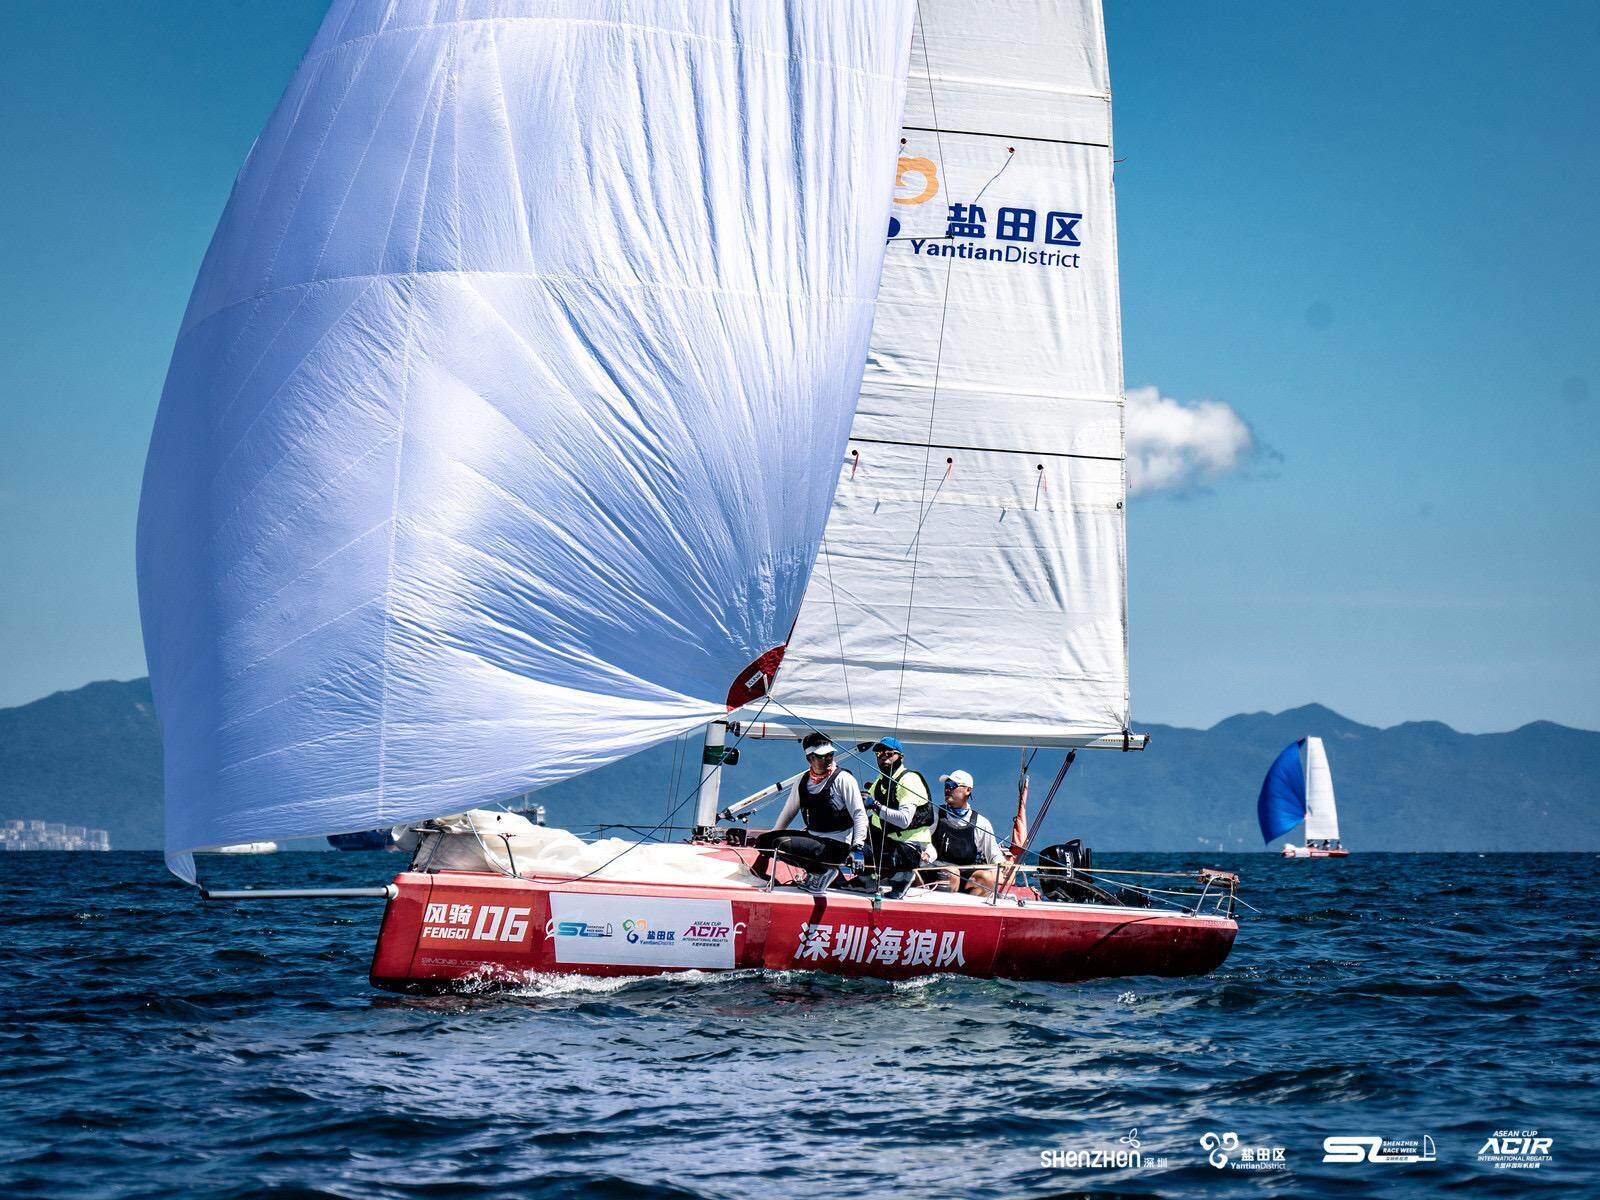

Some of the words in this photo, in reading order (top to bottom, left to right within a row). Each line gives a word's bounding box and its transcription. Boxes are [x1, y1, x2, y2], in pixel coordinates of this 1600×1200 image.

[946, 203, 1083, 246] 盐田区
[911, 239, 1081, 268] YantianDistrict
[423, 903, 473, 925] 风骑
[472, 905, 531, 942] 06
[422, 926, 471, 940] FENGQI
[647, 930, 675, 940] 盐田区
[683, 926, 730, 937] ACIR
[794, 921, 967, 968] 深圳海狼队
